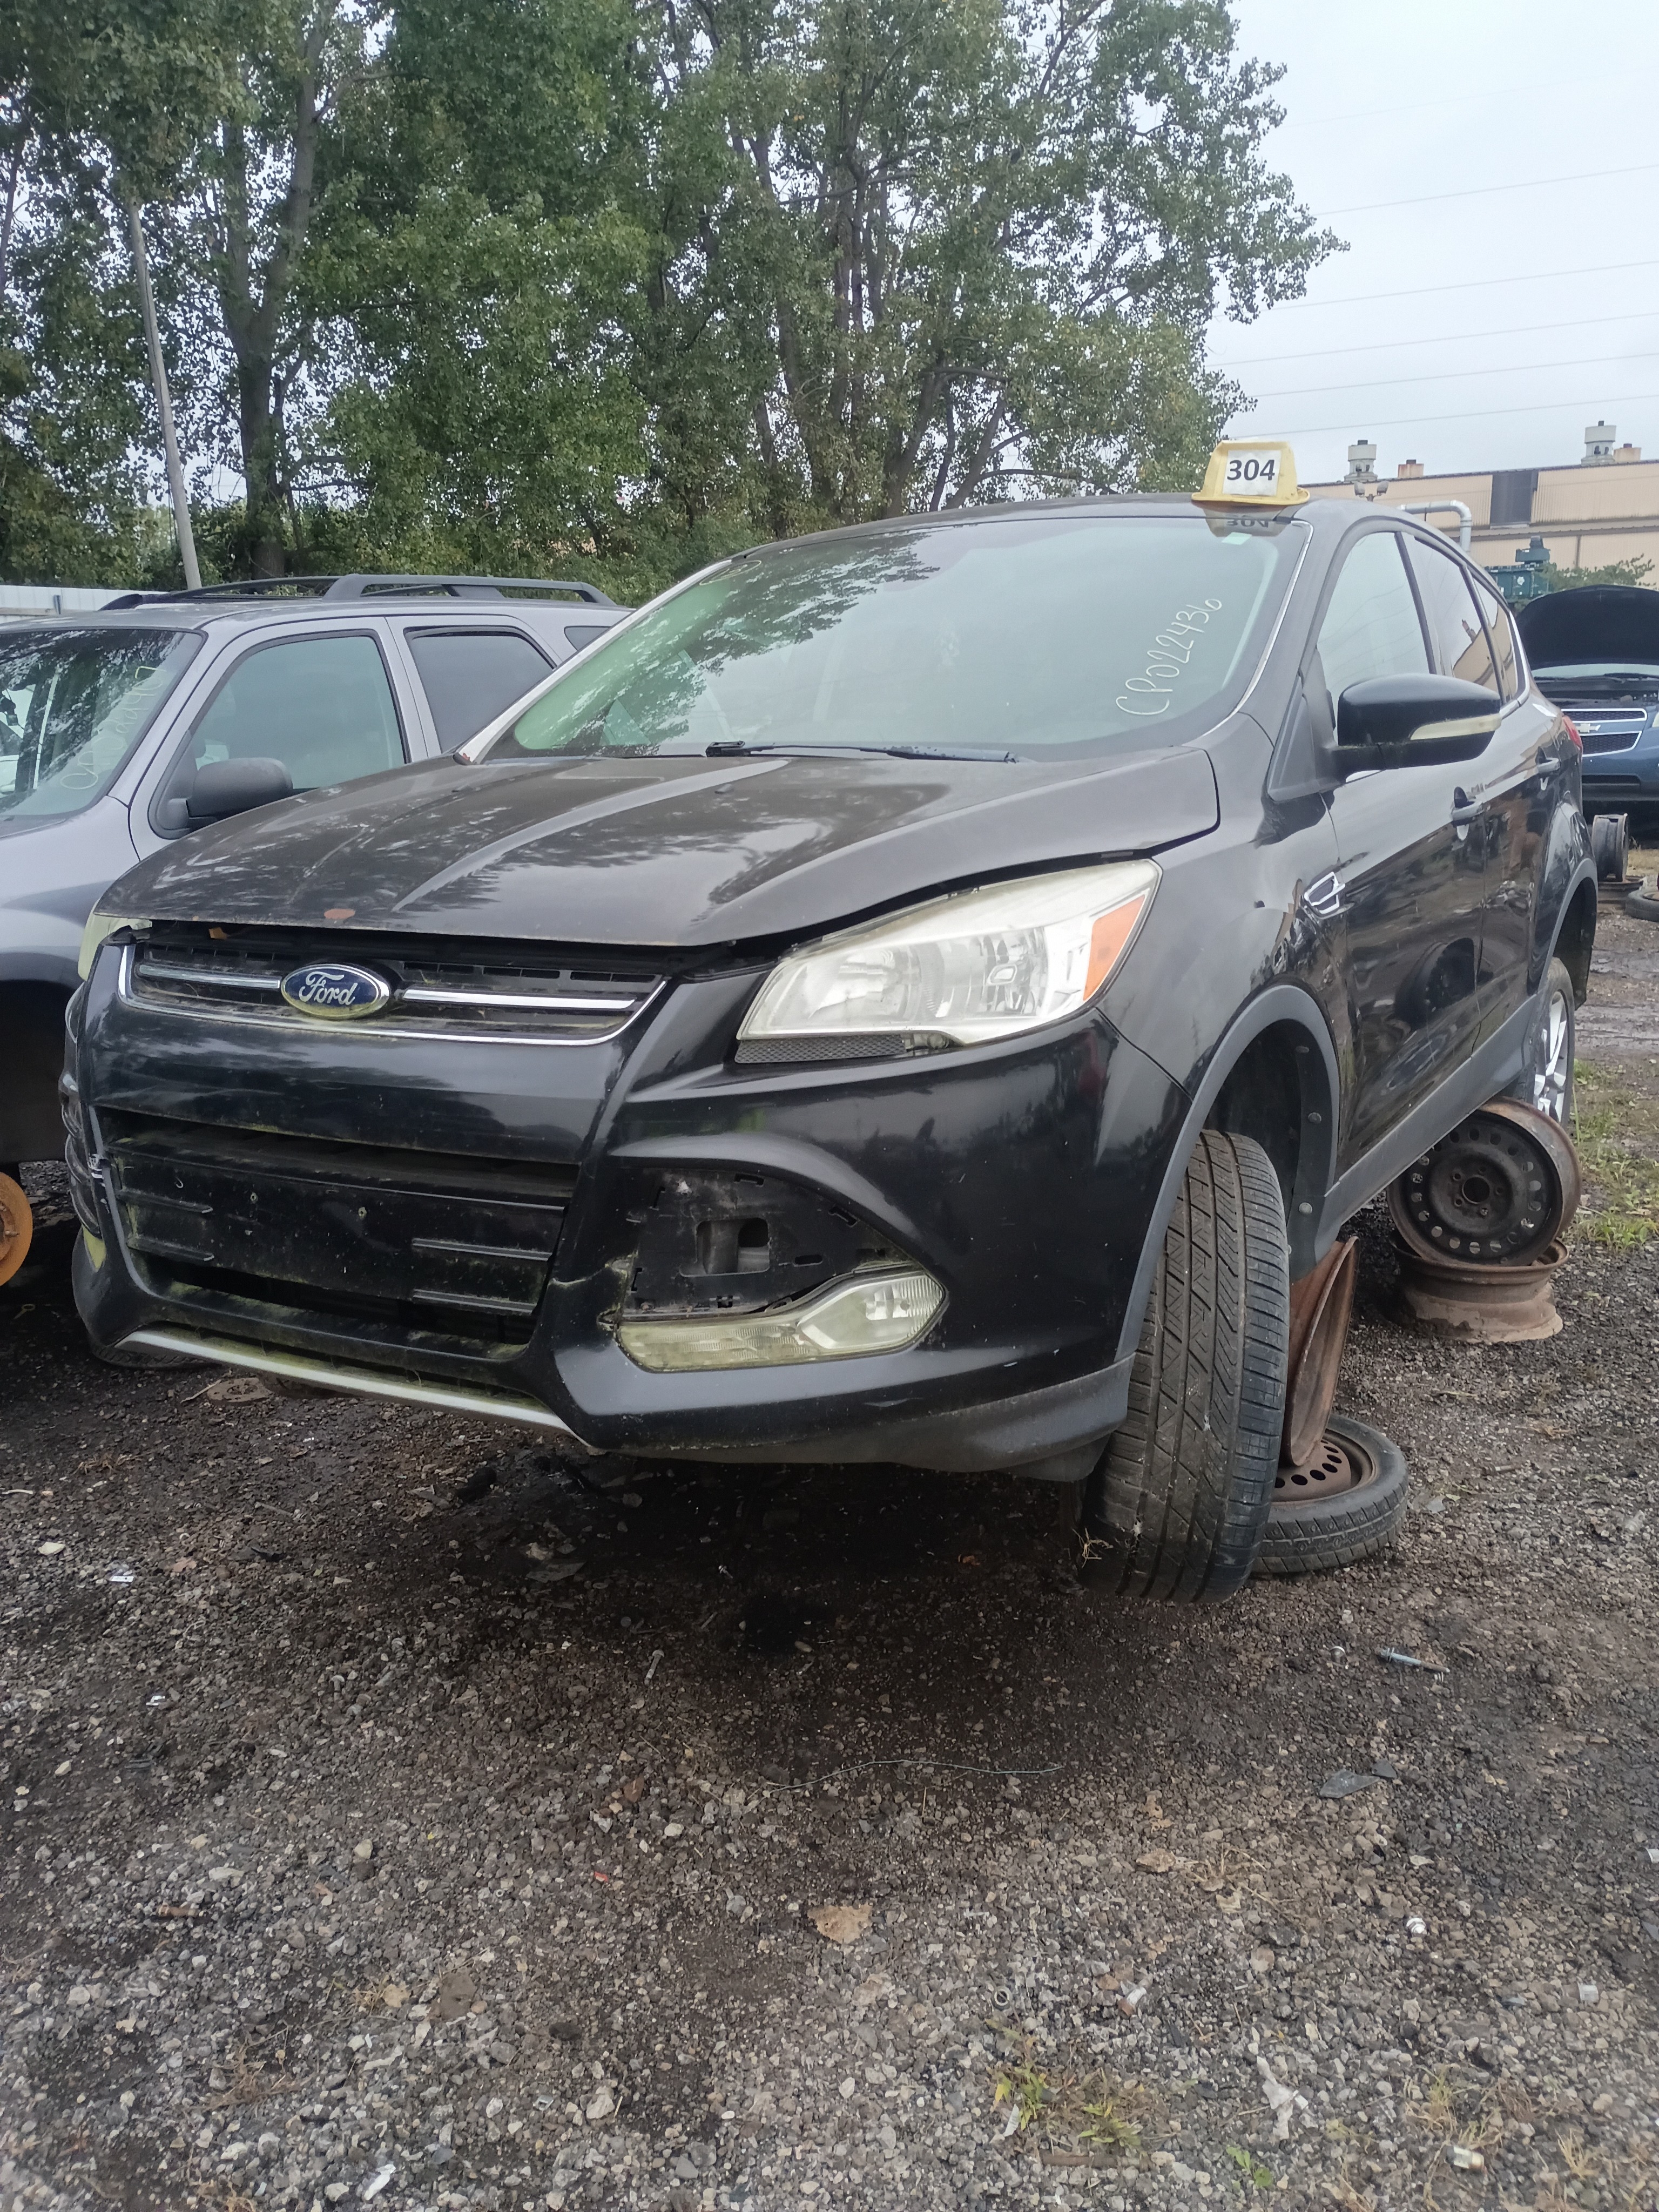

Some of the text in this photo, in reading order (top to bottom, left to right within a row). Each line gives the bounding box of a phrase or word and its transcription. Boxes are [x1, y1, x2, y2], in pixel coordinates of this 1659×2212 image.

[1226, 459, 1275, 481] 304
[1116, 598, 1223, 715] CP022436
[298, 971, 358, 1006] Ford
